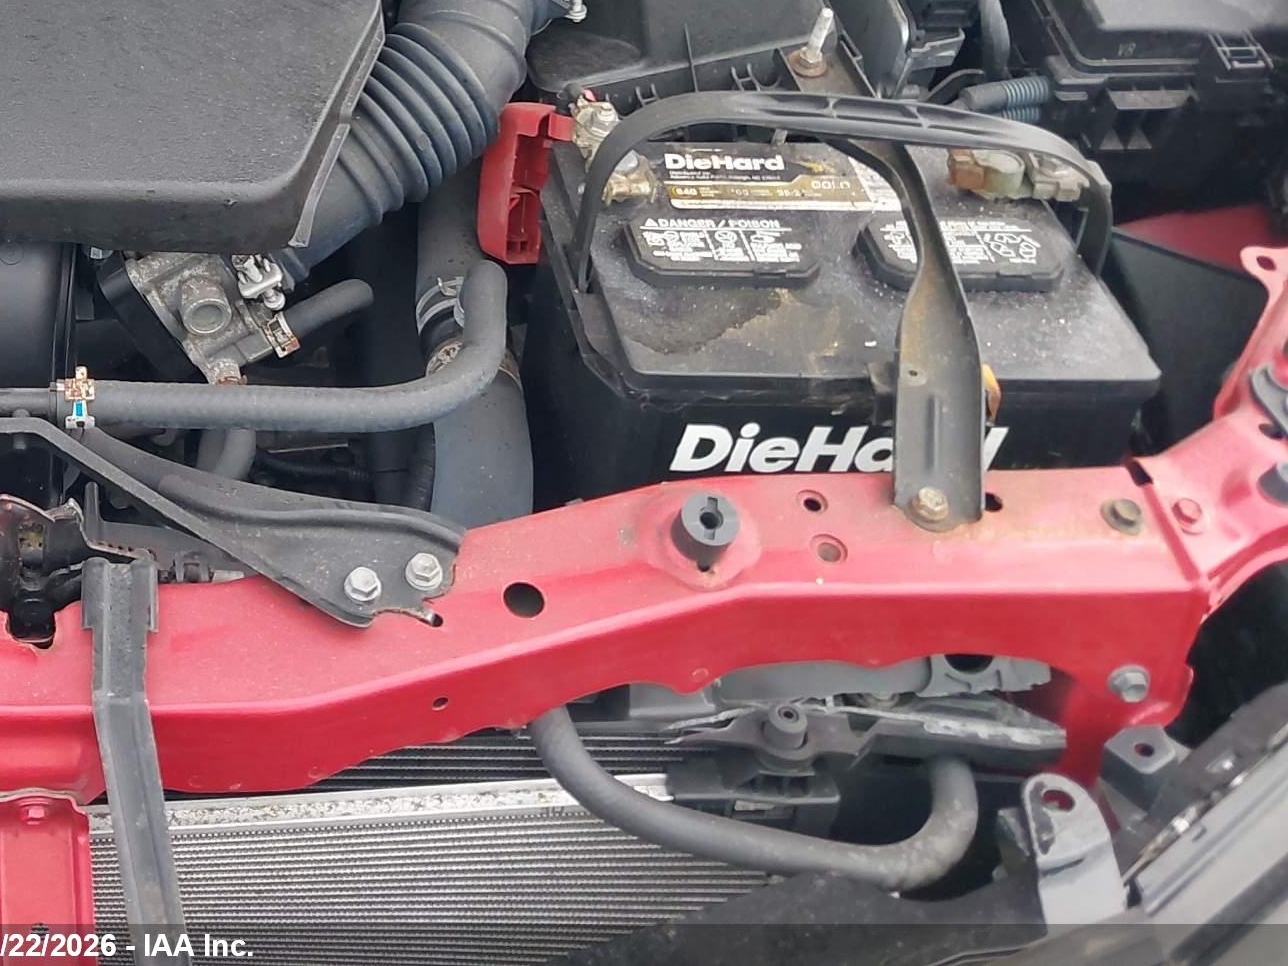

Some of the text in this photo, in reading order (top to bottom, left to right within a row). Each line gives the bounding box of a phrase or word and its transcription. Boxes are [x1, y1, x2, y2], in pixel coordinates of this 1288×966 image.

[664, 153, 785, 172] DieHard
[657, 218, 715, 228] DANGER
[728, 219, 781, 229] POISON
[669, 422, 1009, 473] DieHa
